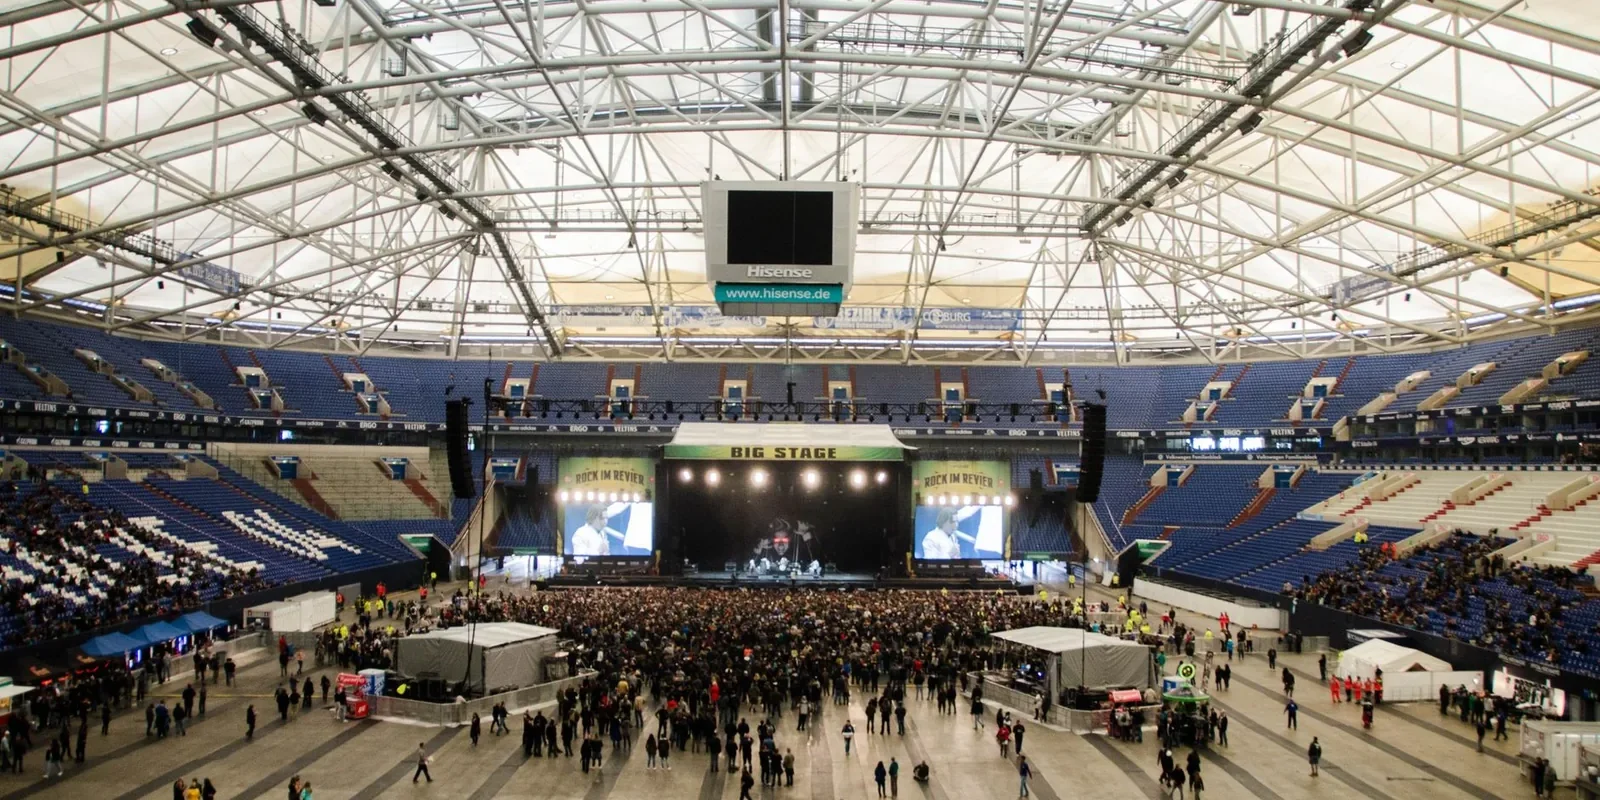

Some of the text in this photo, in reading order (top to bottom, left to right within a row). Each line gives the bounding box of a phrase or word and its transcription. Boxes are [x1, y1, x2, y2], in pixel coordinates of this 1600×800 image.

[747, 265, 812, 278] Hisense
[726, 288, 831, 300] www.hisense.de
[34, 403, 57, 412] VELTINS
[731, 447, 837, 459] BIG STAGE
[575, 470, 645, 486] ROCK IM REVIER
[924, 473, 994, 488] ROCK IM REVIER
